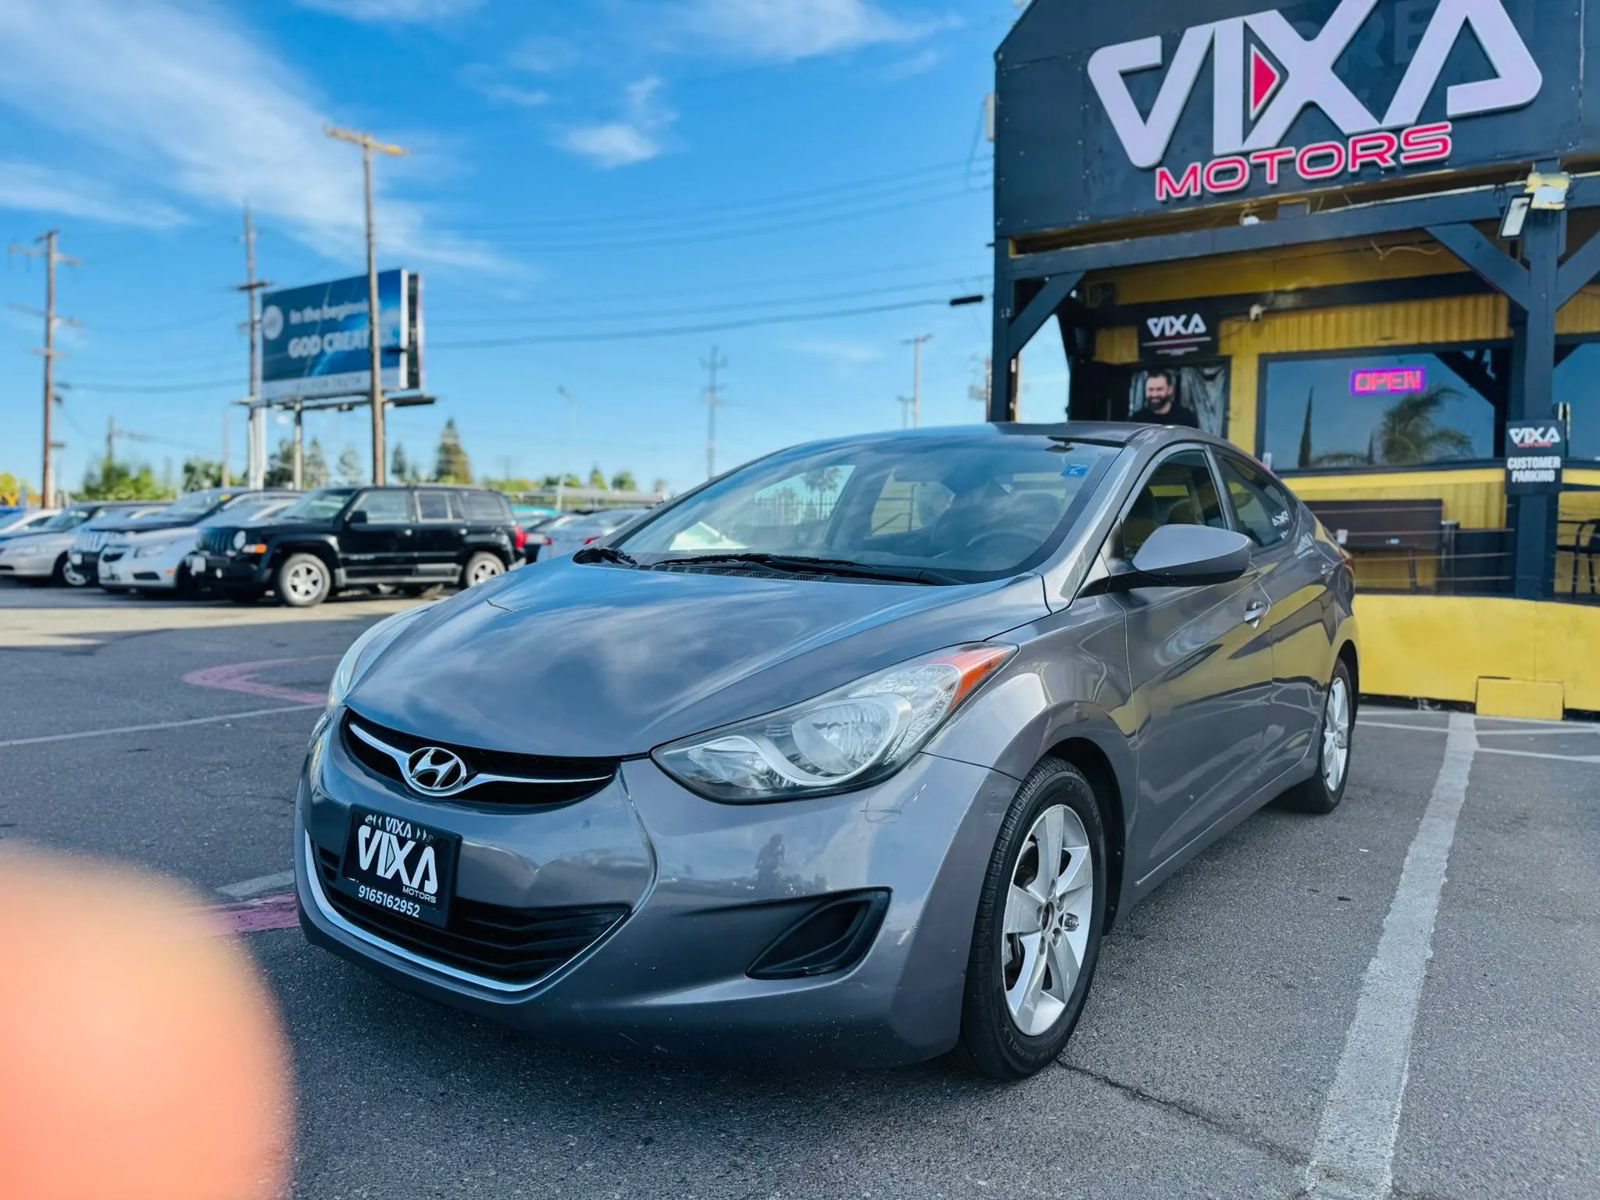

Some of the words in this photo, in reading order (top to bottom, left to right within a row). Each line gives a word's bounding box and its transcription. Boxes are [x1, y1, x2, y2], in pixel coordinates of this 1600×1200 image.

[1087, 0, 1543, 169] VIXA
[1155, 121, 1453, 201] MOTORS
[1147, 313, 1207, 338] VIXA
[289, 336, 321, 358] GOD
[1355, 370, 1421, 391] OPEN
[1508, 426, 1561, 444] VIXA
[1507, 456, 1561, 470] CUSTOMER
[1511, 469, 1556, 483] PARKING
[385, 816, 412, 839] VIXA
[358, 825, 438, 894] VIXA
[358, 884, 420, 918] 9165162952
[402, 885, 437, 904] MOTORS
